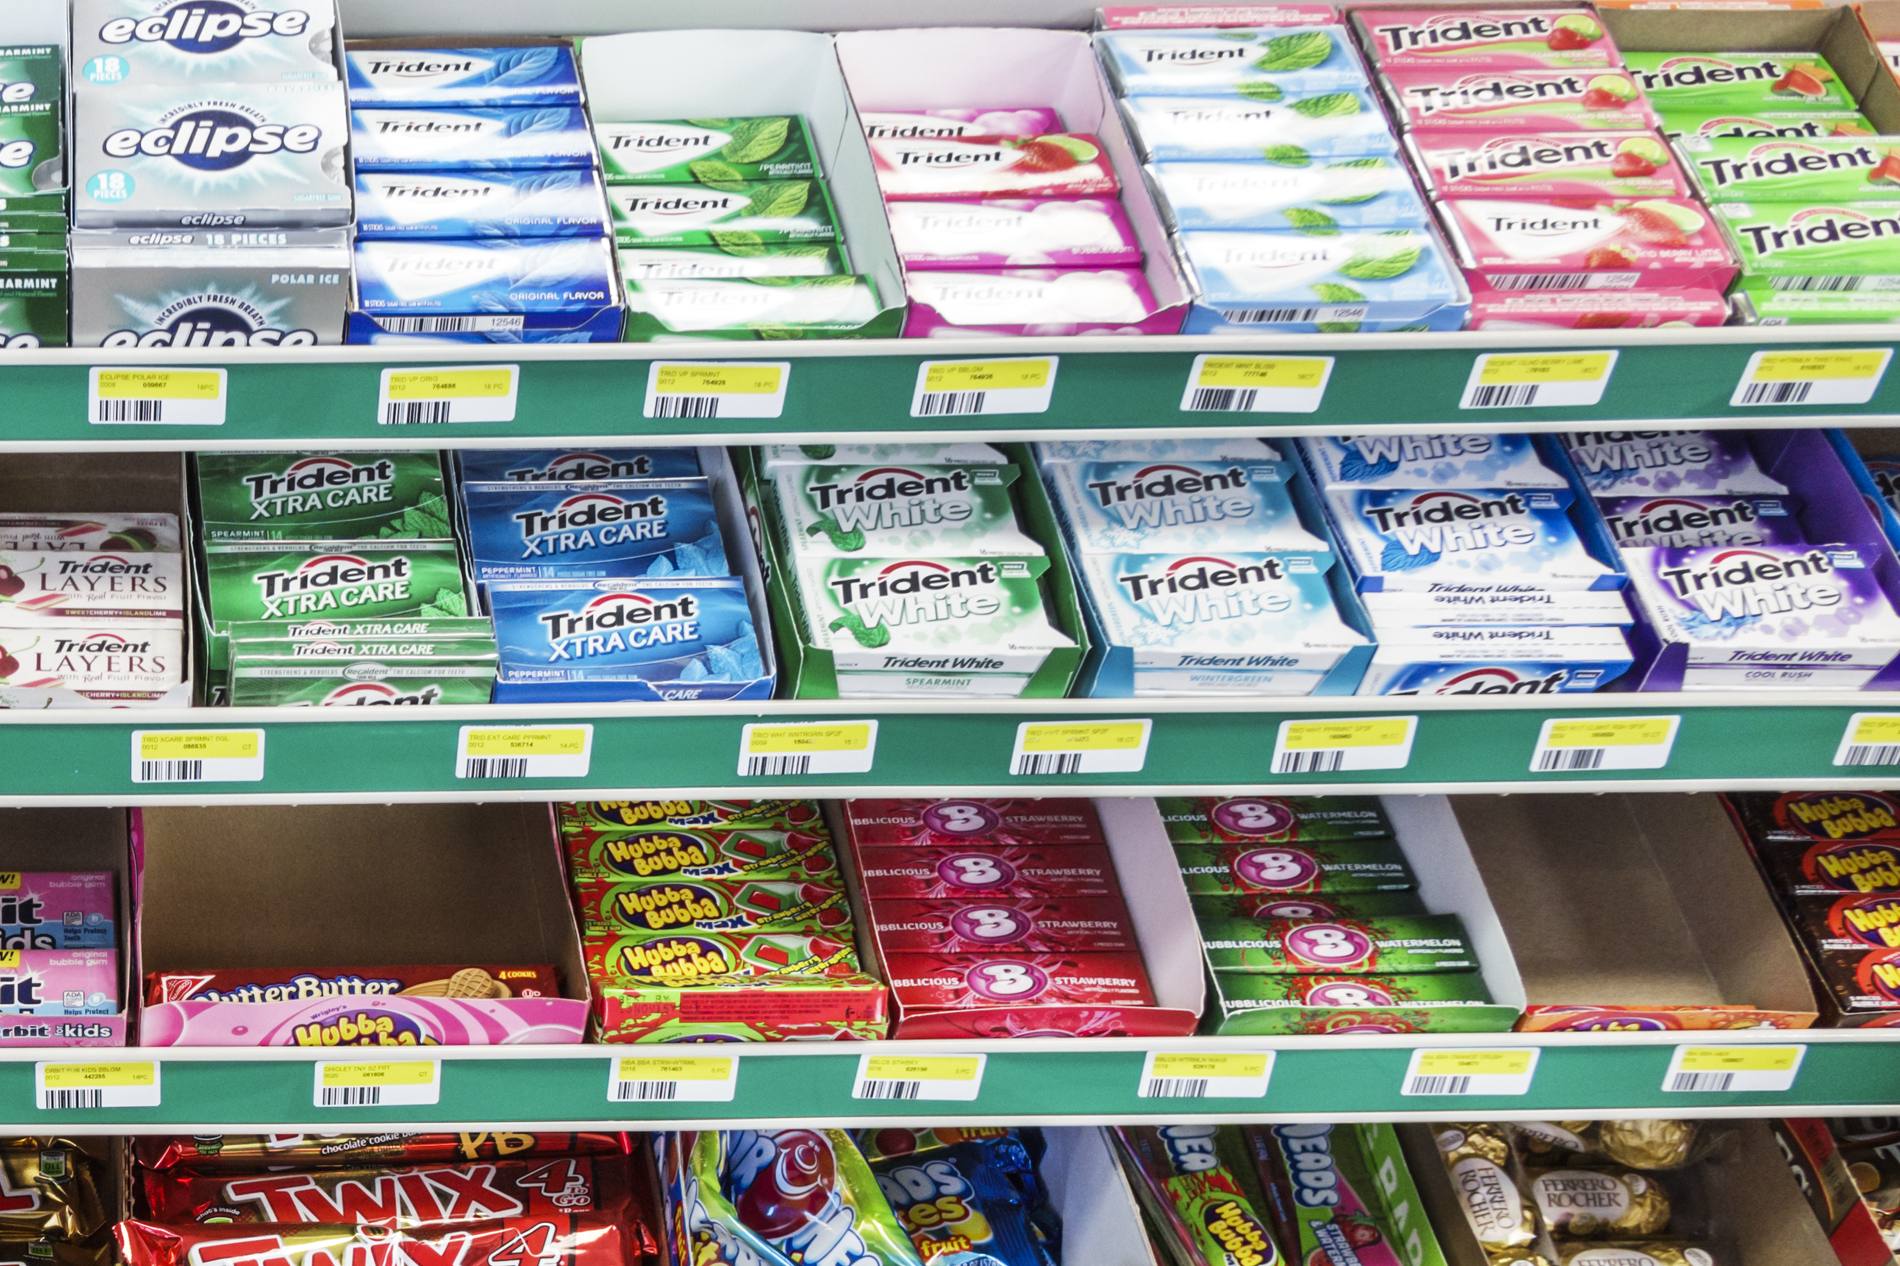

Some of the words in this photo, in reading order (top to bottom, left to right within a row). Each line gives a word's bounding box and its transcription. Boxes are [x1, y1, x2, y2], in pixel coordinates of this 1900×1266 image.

[1379, 15, 1550, 54] Trident
[1140, 45, 1249, 64] Trident
[366, 58, 476, 78] Trident
[103, 119, 319, 159] eclipse
[608, 131, 712, 152] Trident
[1701, 145, 1879, 189] Trident
[271, 272, 319, 286] POLAR
[322, 272, 341, 286] ICE
[509, 291, 559, 302] ORIGINAL
[562, 291, 605, 301] FLAVOR
[489, 317, 522, 328] 12546
[131, 373, 156, 381] POLAR
[158, 373, 170, 381] ICE
[257, 557, 408, 598] Trident
[830, 561, 996, 606] Trident
[1664, 552, 1831, 599] Trident
[261, 585, 335, 619] XTRA
[339, 580, 409, 607] CARE
[1694, 582, 1842, 621] White
[855, 593, 1000, 629] White
[289, 622, 349, 638] Trident
[354, 622, 386, 634] XTRA
[389, 622, 429, 634] CARE
[54, 638, 150, 656] Trident
[35, 653, 166, 674] LAYERS
[882, 656, 949, 670] Trident
[952, 656, 1003, 670] White
[508, 669, 565, 679] PEPPERMINT
[905, 677, 972, 687] SPEARMINT
[1189, 674, 1273, 684] WINTERGREEN
[1744, 670, 1775, 679] COOL
[1779, 670, 1814, 679] RUSH
[469, 734, 488, 742] TRID
[609, 833, 683, 862] Hubba
[636, 845, 706, 877] Bubba
[1376, 938, 1462, 948] WATERMELON
[508, 970, 536, 980] COOKIES
[1054, 976, 1137, 988] STRAWBERRY
